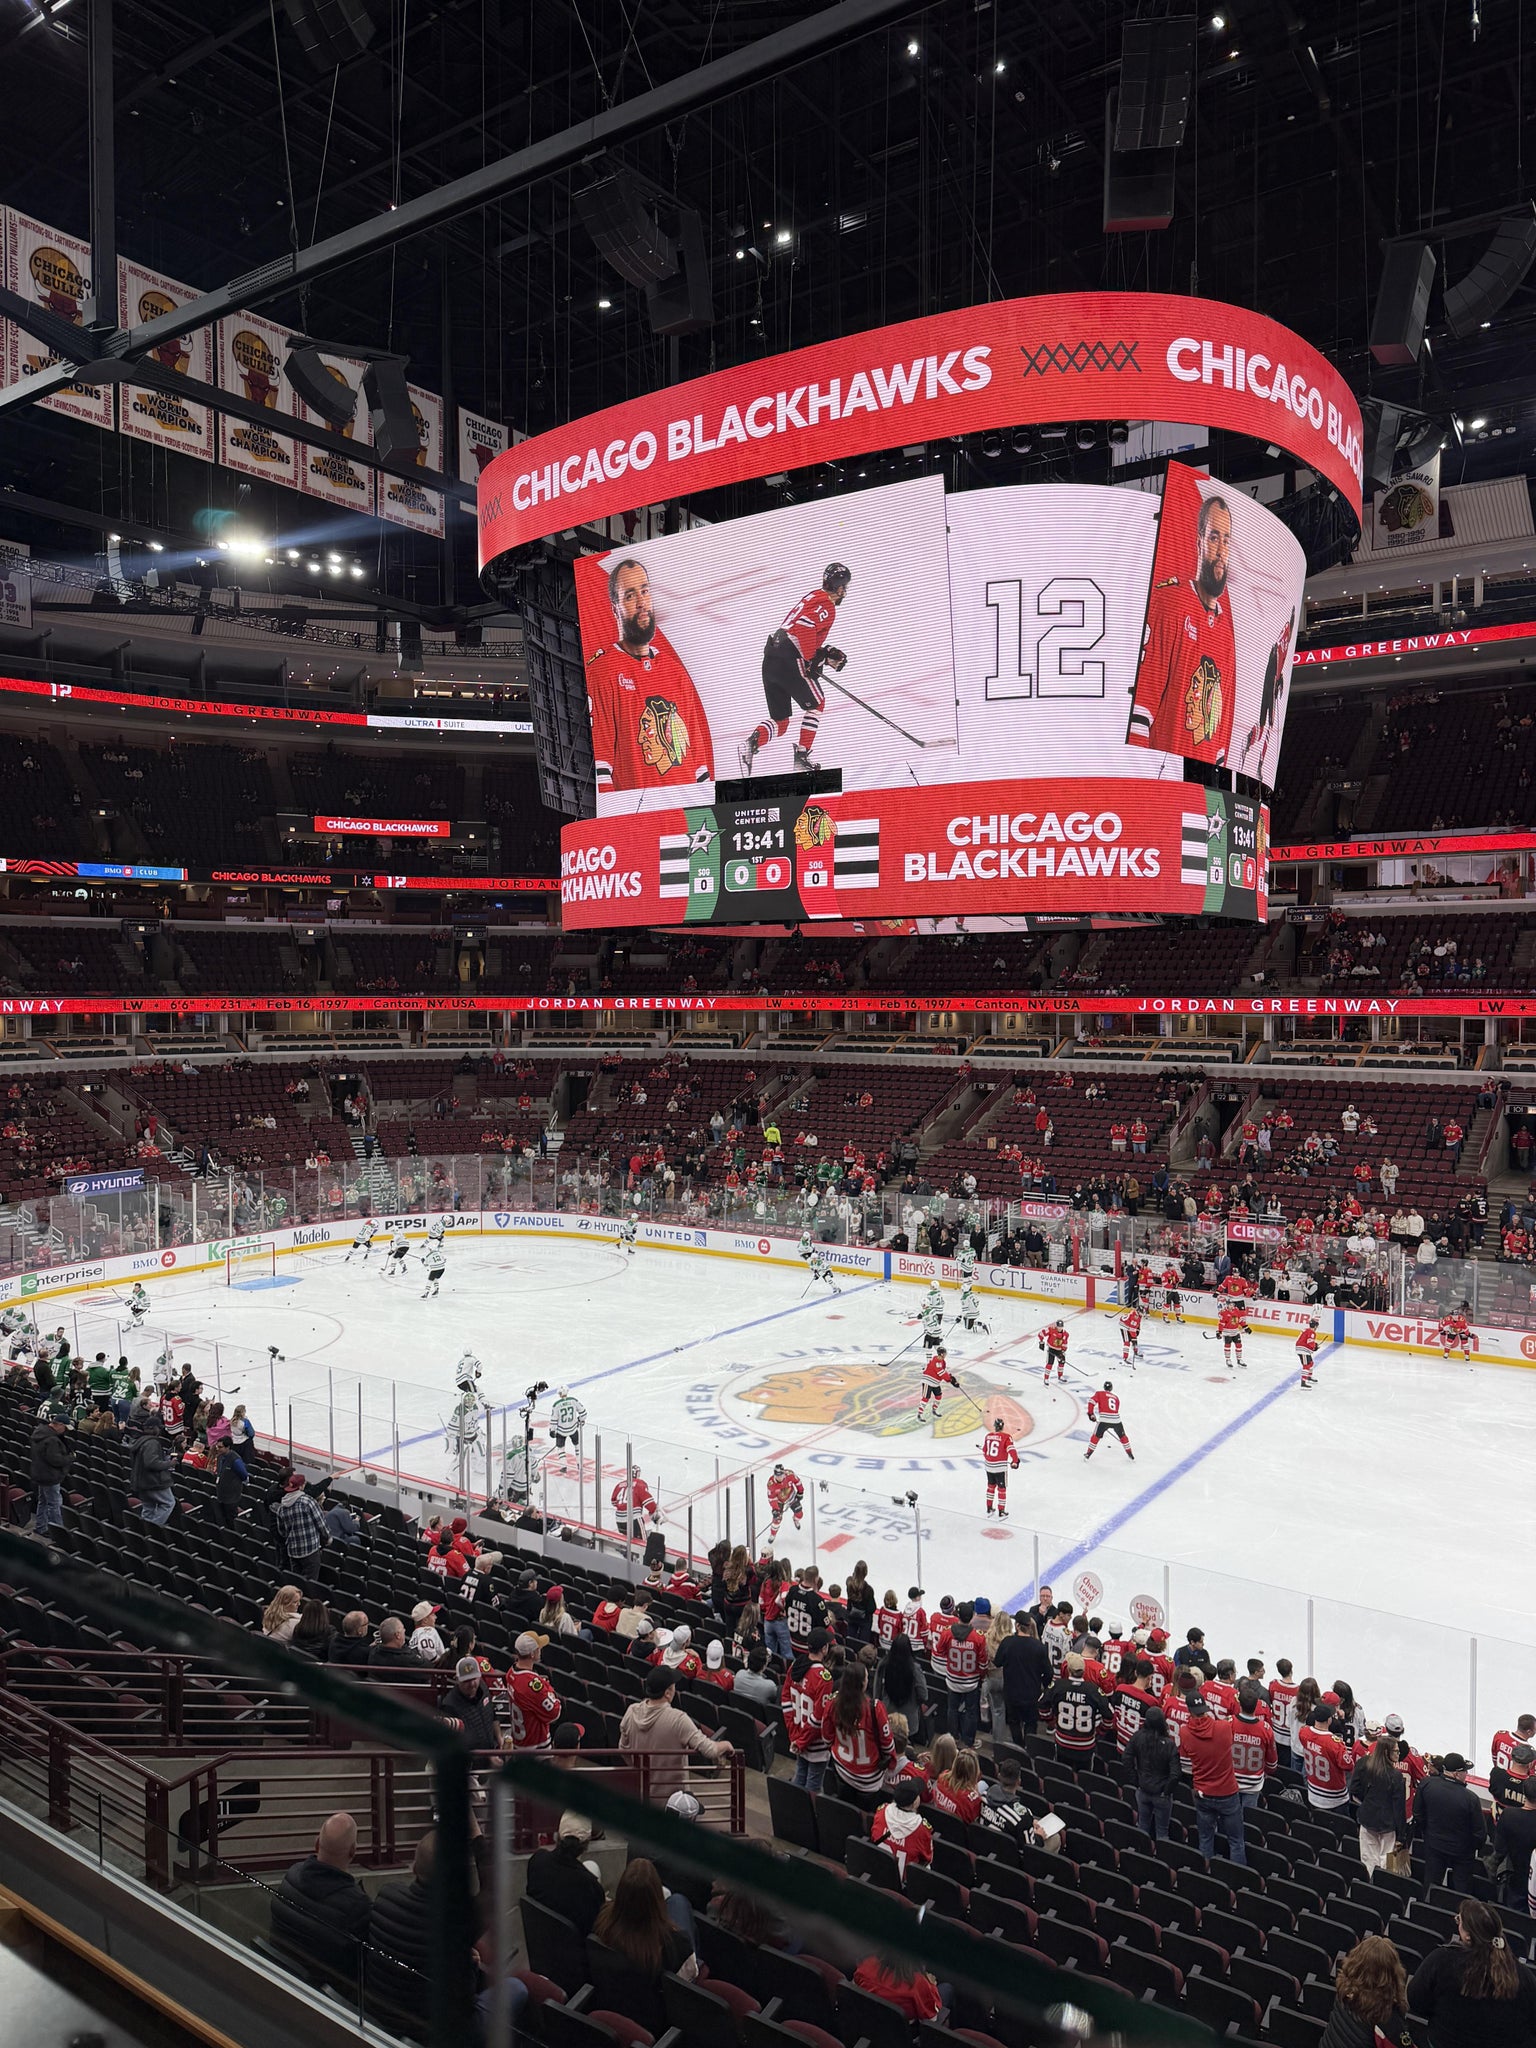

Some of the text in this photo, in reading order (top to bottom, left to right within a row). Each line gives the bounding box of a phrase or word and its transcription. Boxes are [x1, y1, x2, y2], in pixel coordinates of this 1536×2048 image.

[34, 256, 91, 289] CHICAGO
[42, 273, 84, 300] BULLS
[235, 340, 280, 366] CHICAGO
[242, 354, 275, 376] BULLS
[1166, 337, 1323, 430] CHICAGO
[147, 394, 189, 418] WORLD
[132, 402, 202, 435] CHAMPIONS
[465, 417, 503, 440] CHICAGO
[512, 430, 657, 511] CHICAGO
[667, 346, 992, 462] BLACKHAWKS
[242, 429, 279, 449] WORLD
[471, 431, 498, 448] BULLS
[230, 437, 291, 465] CHAMPIONS
[322, 457, 354, 475] WORLD
[310, 464, 365, 491] CHAMPIONS
[1406, 472, 1434, 486] SAVARD
[397, 484, 427, 501] WORLD
[387, 491, 437, 516] CHAMPIONS
[814, 605, 829, 622] 12
[985, 579, 1106, 701] 12
[1345, 631, 1472, 657] GREENWAY
[50, 683, 335, 721] 12 JORDAN GREENWAY
[404, 719, 435, 728] ULTRA
[443, 721, 465, 729] SUITE
[735, 808, 767, 818] UNITED
[735, 816, 767, 825] CENTER
[326, 820, 439, 833] CHICAGO BLACKHAWKS
[946, 812, 1122, 846] CHICAGO
[732, 829, 785, 852] 13:41
[1233, 826, 1255, 849] 13:41
[1307, 841, 1441, 858] GREENWAY
[751, 856, 763, 864] 1ST
[904, 847, 1161, 882] BLACKHAWKS
[104, 867, 158, 877] BMO CLUB
[212, 871, 332, 884] CHICAGO BLACKHAWKS
[734, 863, 781, 885] 0 0
[812, 873, 819, 885] 0
[386, 876, 559, 889] 12 JORDAN
[700, 879, 707, 891] 0
[123, 1000, 144, 1011] LW
[221, 999, 242, 1010] 231
[266, 999, 292, 1010] Feb
[296, 999, 315, 1011] 16,
[319, 999, 349, 1010] 1997
[374, 999, 423, 1011] Canton,
[427, 999, 448, 1011] NY,
[452, 999, 477, 1010] USA
[527, 998, 603, 1009] JORDAN
[615, 998, 717, 1009] GREENWAY
[766, 999, 783, 1009] LW
[841, 999, 859, 1009] 231
[879, 999, 901, 1010] Feb
[905, 999, 922, 1011] 16,
[925, 999, 951, 1010] 1997
[975, 999, 1023, 1011] Canton,
[1027, 999, 1049, 1011] NY,
[1053, 999, 1080, 1010] USA
[1138, 999, 1235, 1011] JORDAN
[1251, 999, 1399, 1012] GREENWAY
[1478, 1001, 1505, 1013] LW
[91, 1174, 144, 1190] HYUNDA
[1025, 1203, 1057, 1217] CIBC
[1479, 1205, 1486, 1215] 5
[385, 1218, 427, 1231] PEPSI
[513, 1216, 564, 1228] FANDUEL
[293, 1227, 330, 1246] Modelo
[645, 1228, 692, 1242] UNITED
[1232, 1224, 1266, 1238] CIBC
[734, 1239, 756, 1249] BMO
[132, 1257, 158, 1270] BMO
[818, 1249, 872, 1267] etmaster
[22, 1266, 103, 1290] enterprise
[990, 1268, 1032, 1291] GTL
[1040, 1274, 1078, 1285] GUARANTEE
[1040, 1280, 1061, 1289] TRUST
[1040, 1286, 1055, 1294] LIFE
[1108, 1398, 1116, 1411] 6
[560, 1406, 574, 1422] 23
[986, 1440, 999, 1457] 16
[818, 1504, 931, 1540] ULTRA
[820, 1518, 899, 1542] ZERO
[1079, 1585, 1095, 1602] Loud
[1082, 1577, 1100, 1597] Cheer
[1136, 1602, 1158, 1613] Cheer
[787, 1606, 812, 1636] 88
[882, 1624, 893, 1641] 9
[419, 1638, 435, 1649] 00
[951, 1640, 974, 1649] BEDARD
[950, 1648, 977, 1672] 98
[1066, 1691, 1086, 1704] KANE
[1121, 1694, 1142, 1711] TOEWS
[1206, 1692, 1222, 1704] SHAW
[1274, 1691, 1297, 1701] BEDAR
[1058, 1701, 1093, 1733] 88
[1119, 1704, 1141, 1733] 19
[1234, 1734, 1261, 1746] BEDARD
[1306, 1740, 1323, 1755] KANE
[1500, 1742, 1513, 1754] BED
[1232, 1743, 1264, 1772] 98
[935, 1793, 957, 1814] EDARD
[1024, 1828, 1036, 1845] 12
